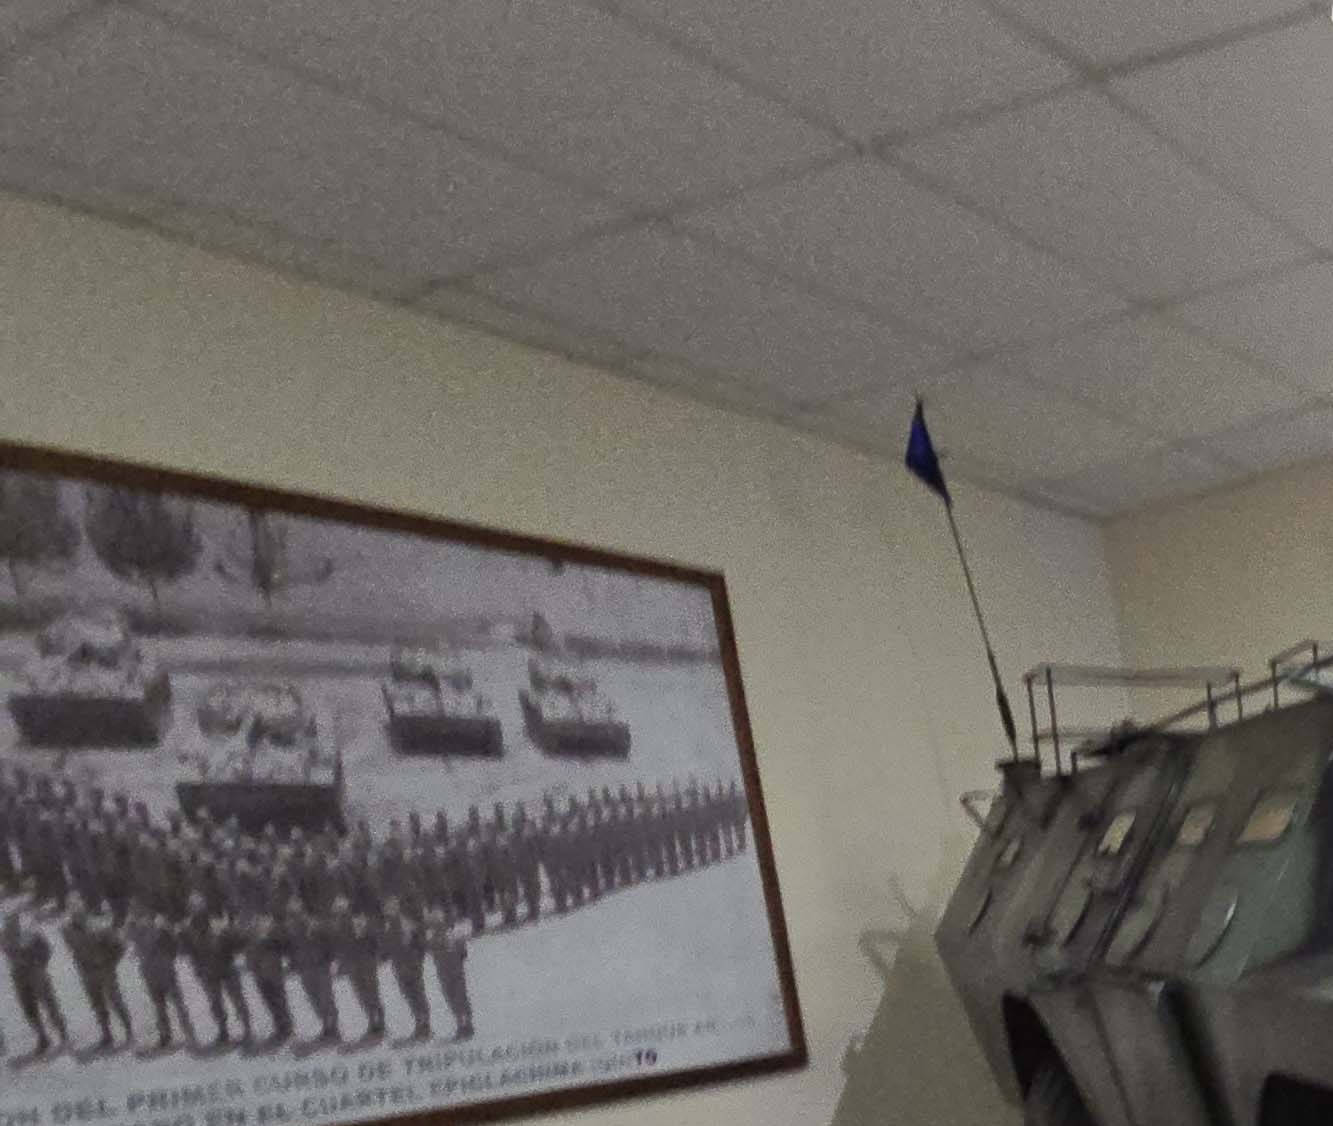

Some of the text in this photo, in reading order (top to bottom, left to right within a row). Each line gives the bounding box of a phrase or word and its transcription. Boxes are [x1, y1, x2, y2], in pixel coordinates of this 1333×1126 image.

[52, 1100, 116, 1124] DEL
[127, 1081, 244, 1111] PRIMER
[254, 1065, 348, 1091] CURSO
[358, 1060, 391, 1082] DE
[257, 1102, 291, 1125] EL
[302, 1088, 417, 1118] CUARTEL
